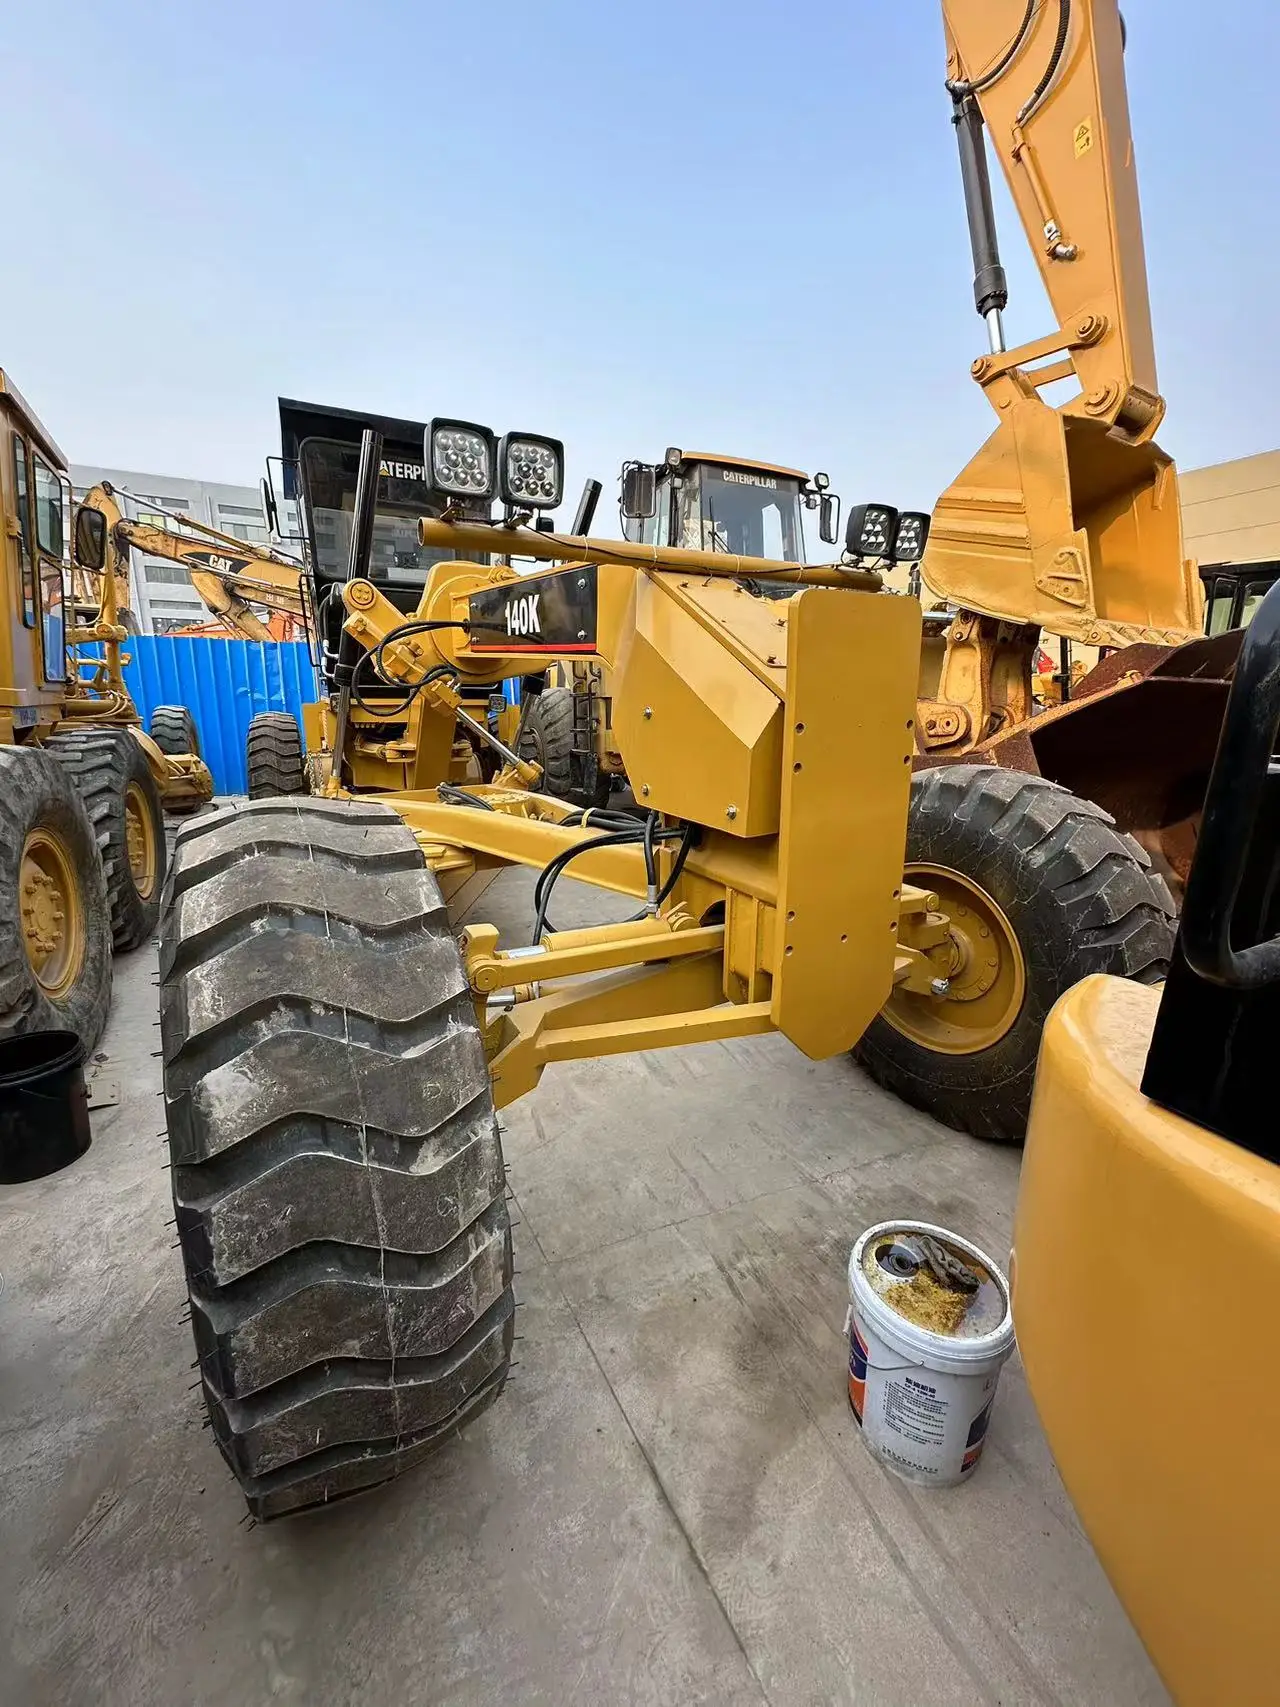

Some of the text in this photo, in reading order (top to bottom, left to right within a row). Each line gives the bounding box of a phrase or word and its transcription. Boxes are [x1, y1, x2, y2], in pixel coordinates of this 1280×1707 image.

[379, 460, 426, 481] ATERPI
[722, 470, 777, 490] CATERPILLAR
[209, 554, 233, 573] CAT
[504, 594, 541, 636] 140K
